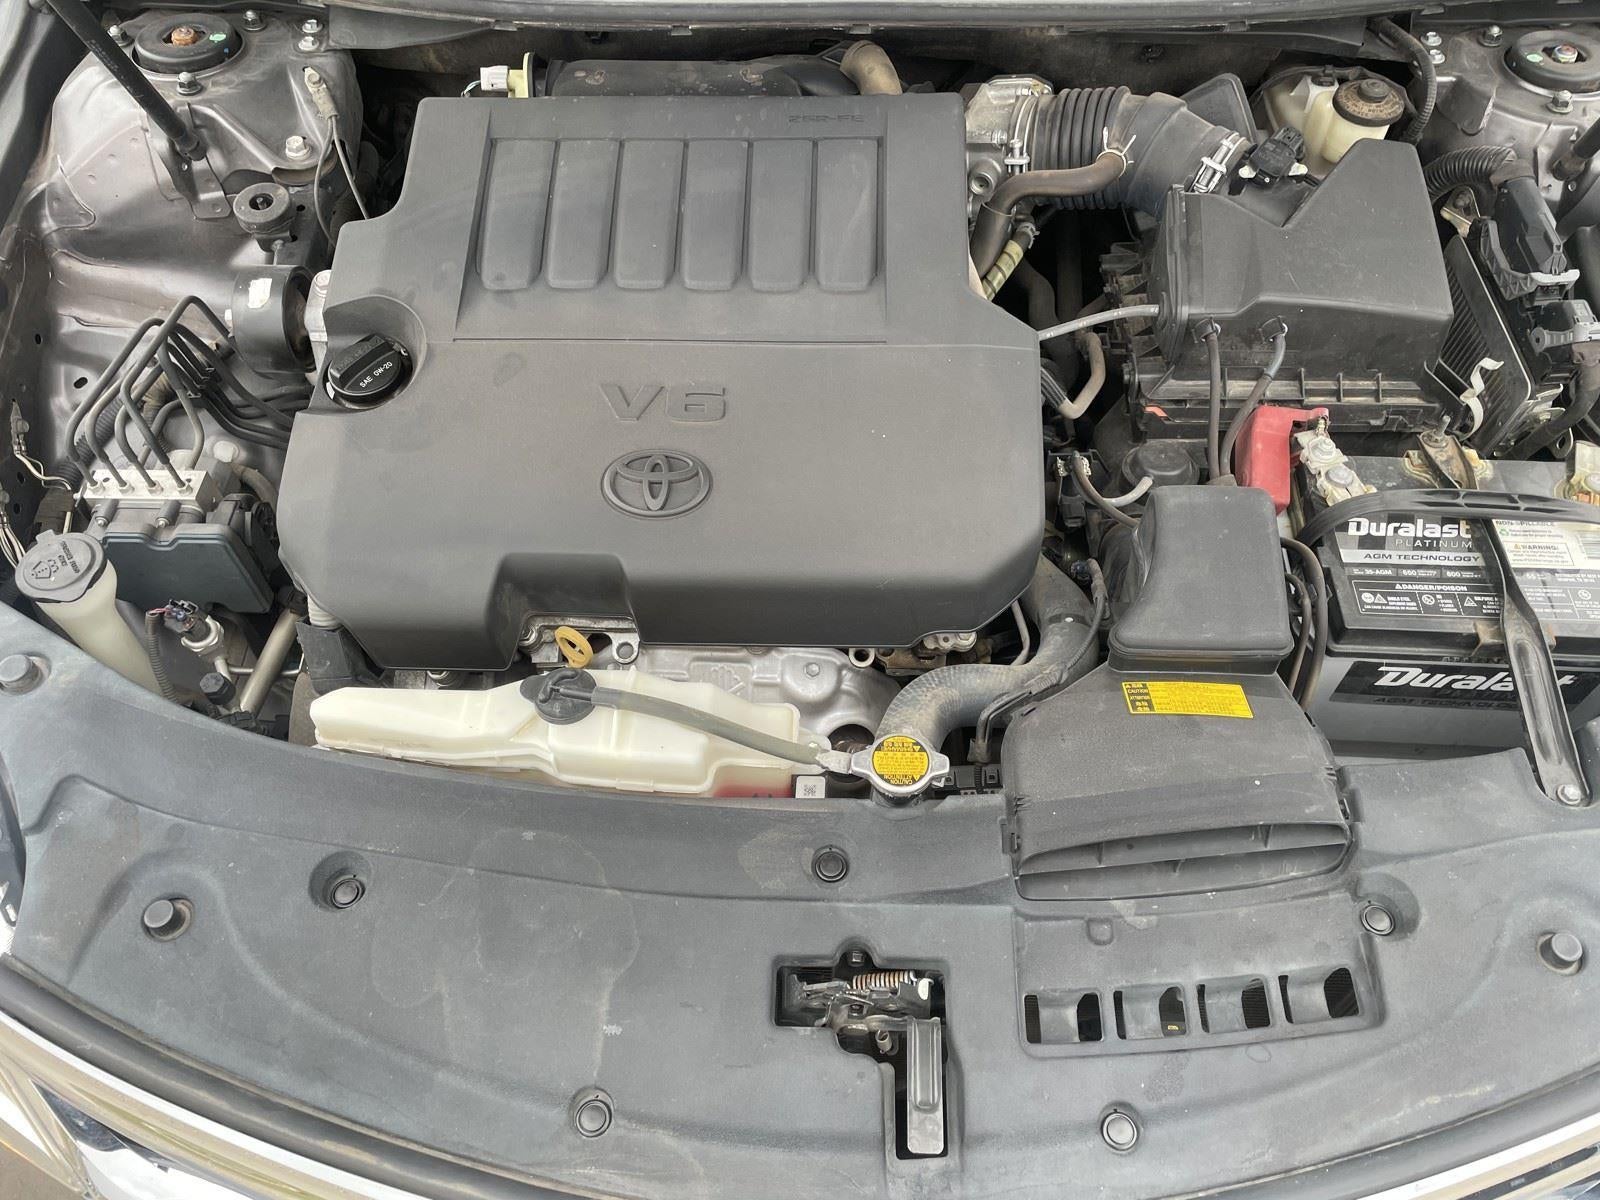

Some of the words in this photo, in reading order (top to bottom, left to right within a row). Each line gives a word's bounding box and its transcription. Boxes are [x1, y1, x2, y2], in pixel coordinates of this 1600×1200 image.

[359, 375, 374, 388] SAE
[373, 361, 393, 377] 0W-20
[599, 383, 727, 424] V6
[1347, 517, 1472, 538] Duralast
[1395, 538, 1473, 549] PLATINUM
[1363, 552, 1393, 561] AGM
[1396, 553, 1481, 563] TECHNOLOGY
[1374, 666, 1577, 691] Duralat
